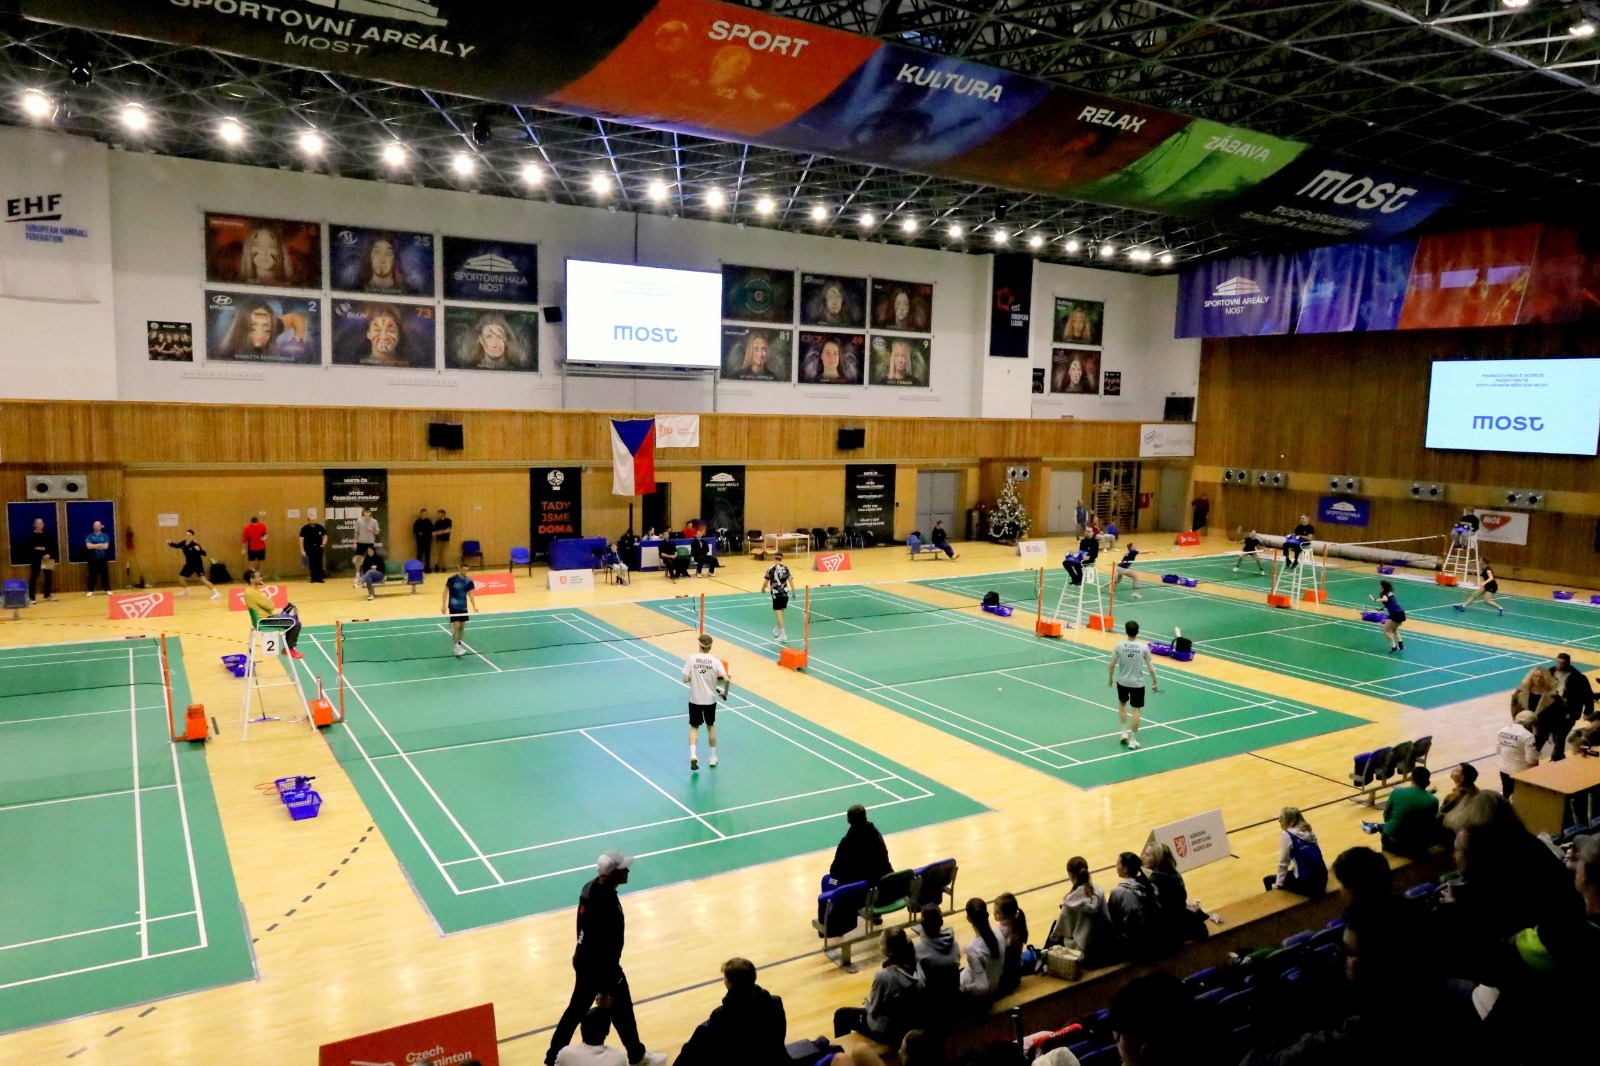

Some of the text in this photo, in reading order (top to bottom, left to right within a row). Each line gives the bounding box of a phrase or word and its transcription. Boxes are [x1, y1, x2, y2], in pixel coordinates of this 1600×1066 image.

[284, 31, 369, 56] MOST
[361, 26, 476, 58] AREÁLY
[708, 20, 809, 58] SPORT
[896, 63, 1003, 103] KULTURA
[1077, 105, 1147, 133] RELAX
[1203, 135, 1271, 162] ZÁBAVA
[7, 193, 62, 216] EHF
[25, 223, 59, 234] EUROPEAN
[25, 232, 64, 242] FEDERATION
[413, 235, 430, 247] 25
[454, 271, 527, 285] SPORTOVNÍ HALA
[478, 283, 504, 292] MOST
[308, 301, 317, 312] 2
[1204, 295, 1270, 307] SPORTOVNÍ AREÁLY
[1225, 306, 1245, 314] MOST
[779, 331, 790, 341] 81
[922, 340, 929, 349] 9
[541, 501, 570, 511] TADY
[541, 513, 570, 522] JSME
[1483, 516, 1500, 524] MOL
[538, 524, 573, 534] DOMA
[266, 640, 275, 652] 2
[1189, 829, 1206, 839] NÁRODNÍ
[1191, 835, 1212, 846] SPORTOVNÍ
[1193, 842, 1213, 853] AGENTURA
[406, 1045, 444, 1063] Czech
